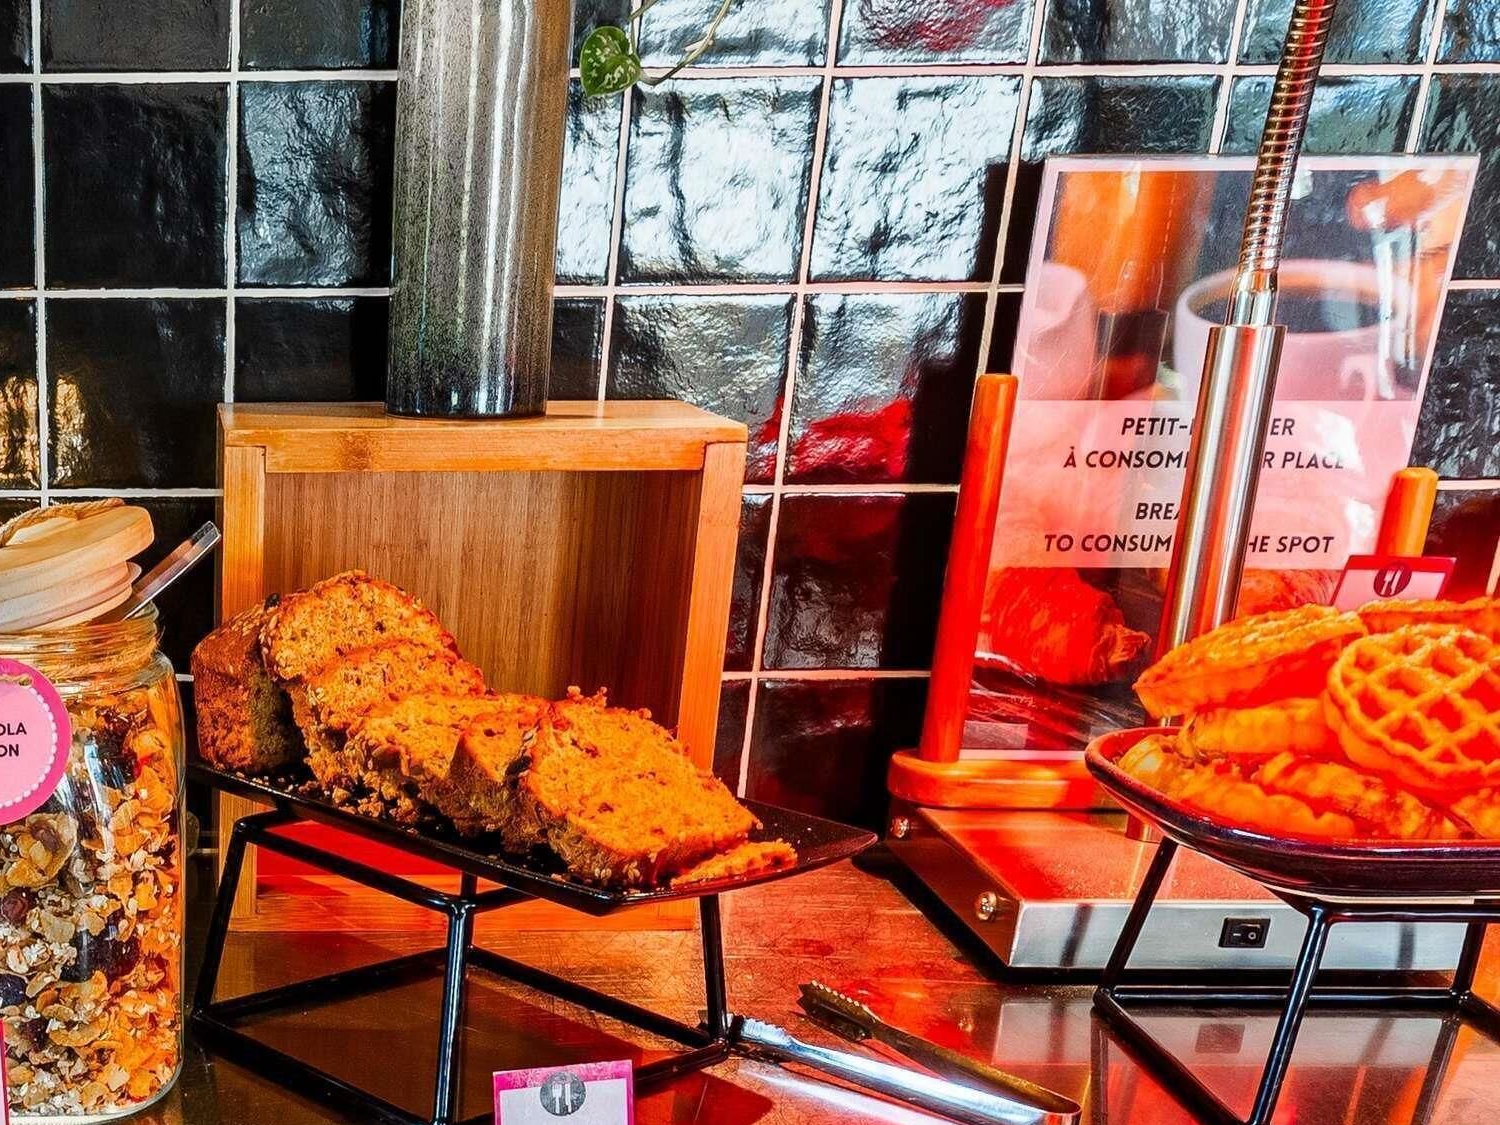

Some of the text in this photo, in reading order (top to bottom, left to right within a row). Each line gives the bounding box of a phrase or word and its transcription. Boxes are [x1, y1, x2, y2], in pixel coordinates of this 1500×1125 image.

[1063, 446, 1077, 468] À
[1085, 450, 1188, 469] CONSOM
[1044, 534, 1074, 552] TO
[1081, 534, 1173, 552] CONSUM
[1276, 536, 1334, 553] SPOT
